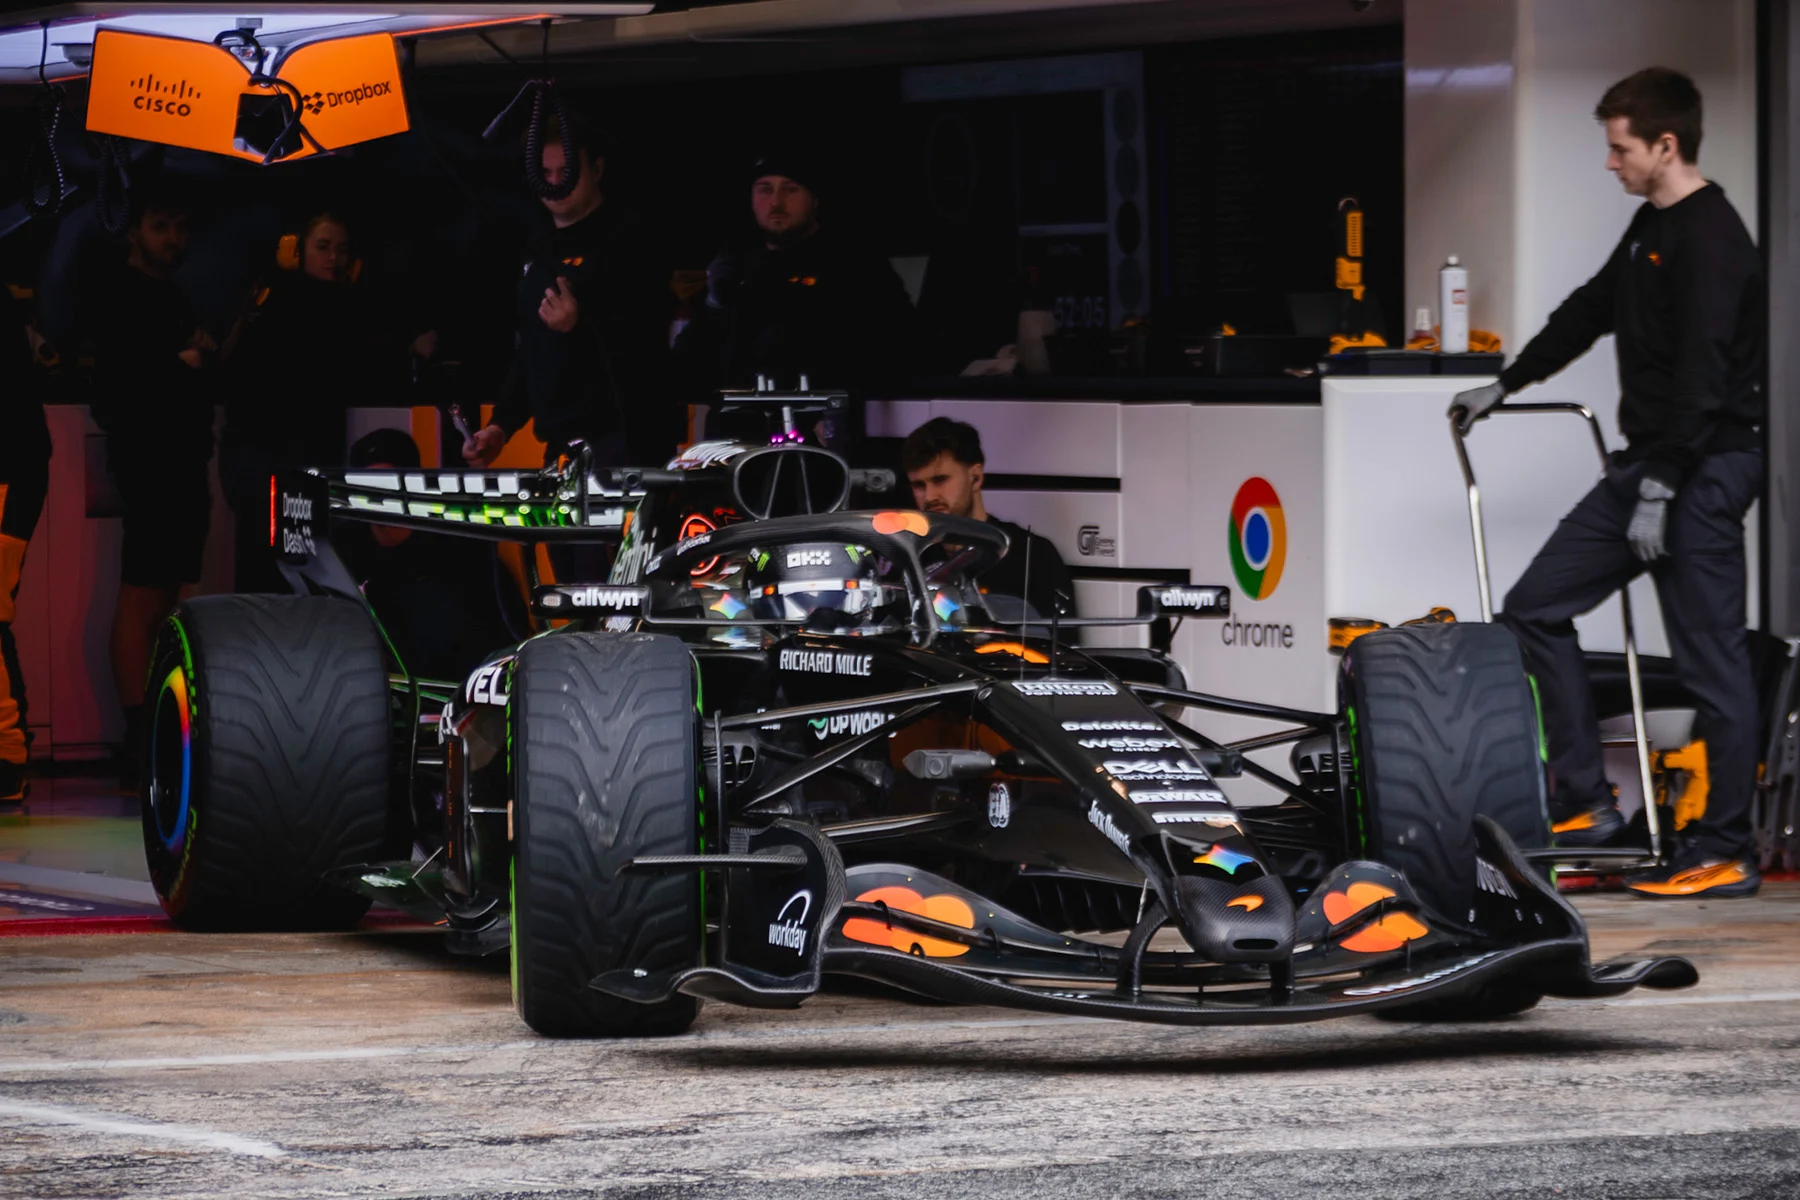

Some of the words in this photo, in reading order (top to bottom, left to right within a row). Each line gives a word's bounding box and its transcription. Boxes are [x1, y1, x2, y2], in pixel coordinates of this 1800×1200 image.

[133, 96, 191, 117] CISCO
[327, 80, 392, 108] Dropbox
[283, 492, 312, 525] Dropbox
[283, 528, 308, 554] Dash
[787, 551, 831, 568] OKX
[571, 587, 639, 611] allwyn
[1160, 587, 1216, 610] allwyn
[1221, 613, 1294, 649] chrome
[779, 650, 833, 674] RICHARD
[835, 654, 873, 677] MILLE
[466, 666, 508, 706] VEL
[1102, 760, 1204, 775] DELL
[768, 919, 807, 957] workday
